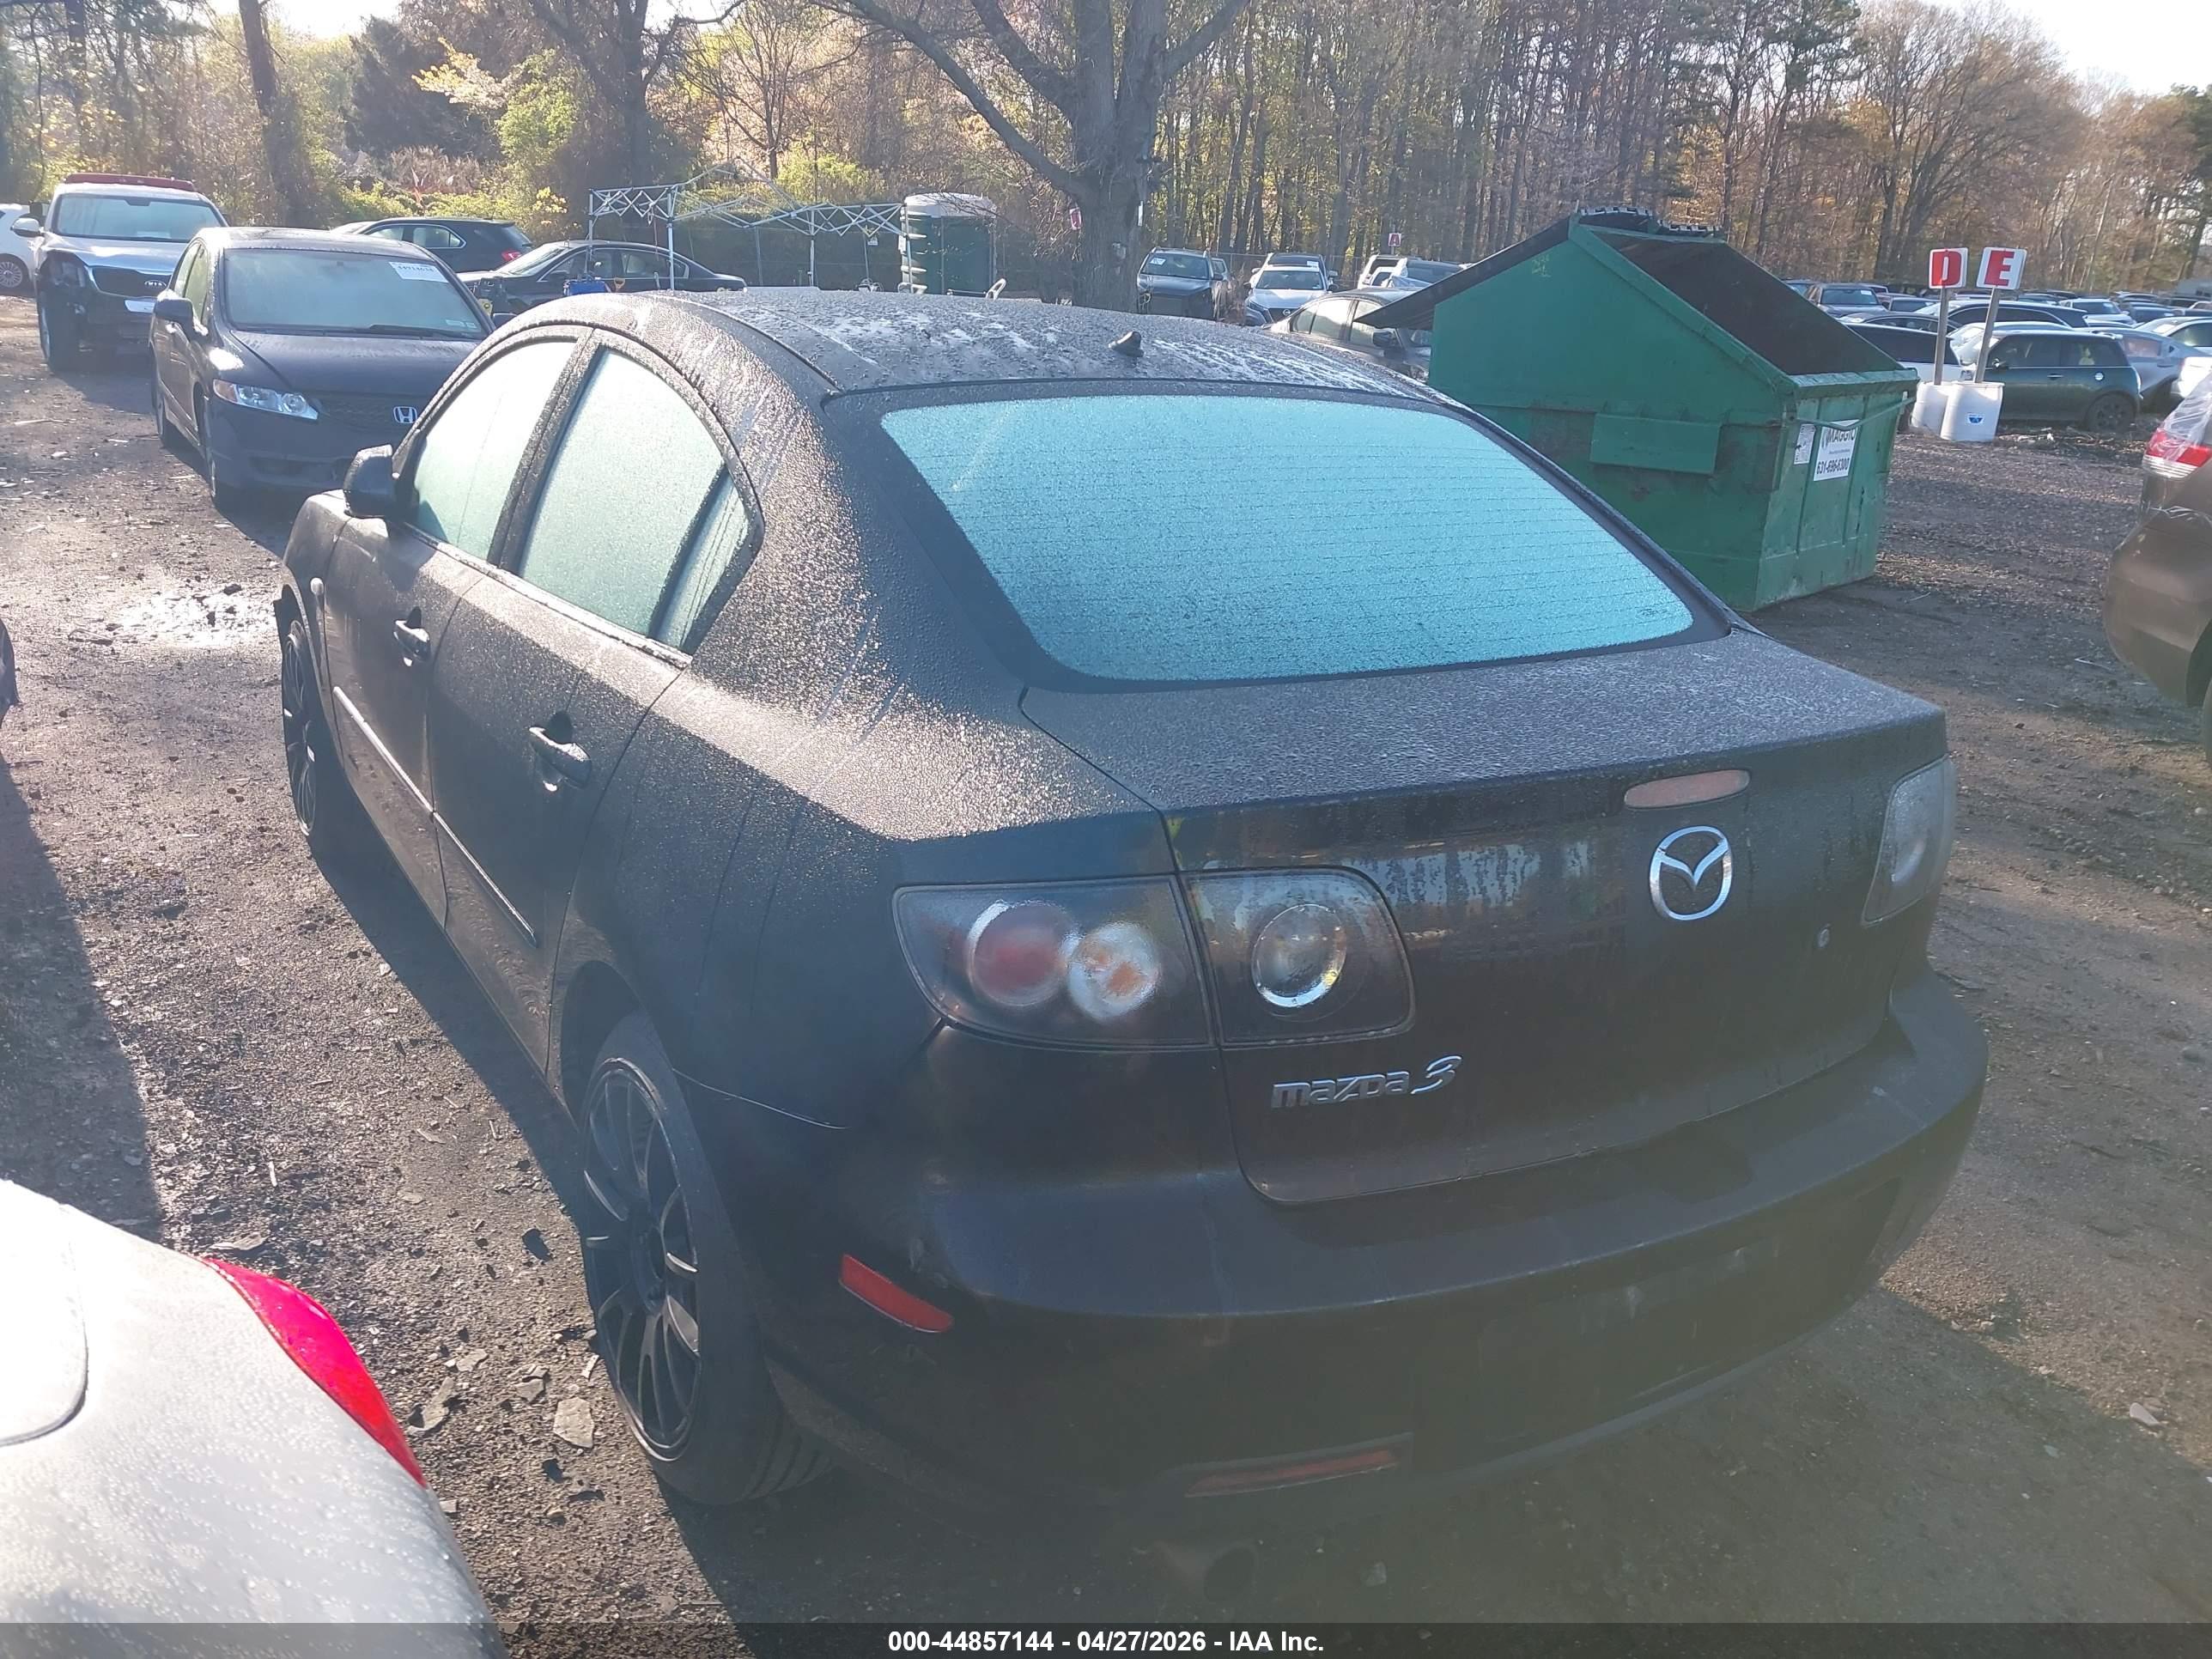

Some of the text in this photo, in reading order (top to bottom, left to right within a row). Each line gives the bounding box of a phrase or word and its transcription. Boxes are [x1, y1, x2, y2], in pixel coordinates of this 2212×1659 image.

[1389, 234, 1401, 246] A
[1931, 250, 1962, 286] D
[1984, 250, 2015, 286] E
[1410, 1054, 1462, 1095] 3
